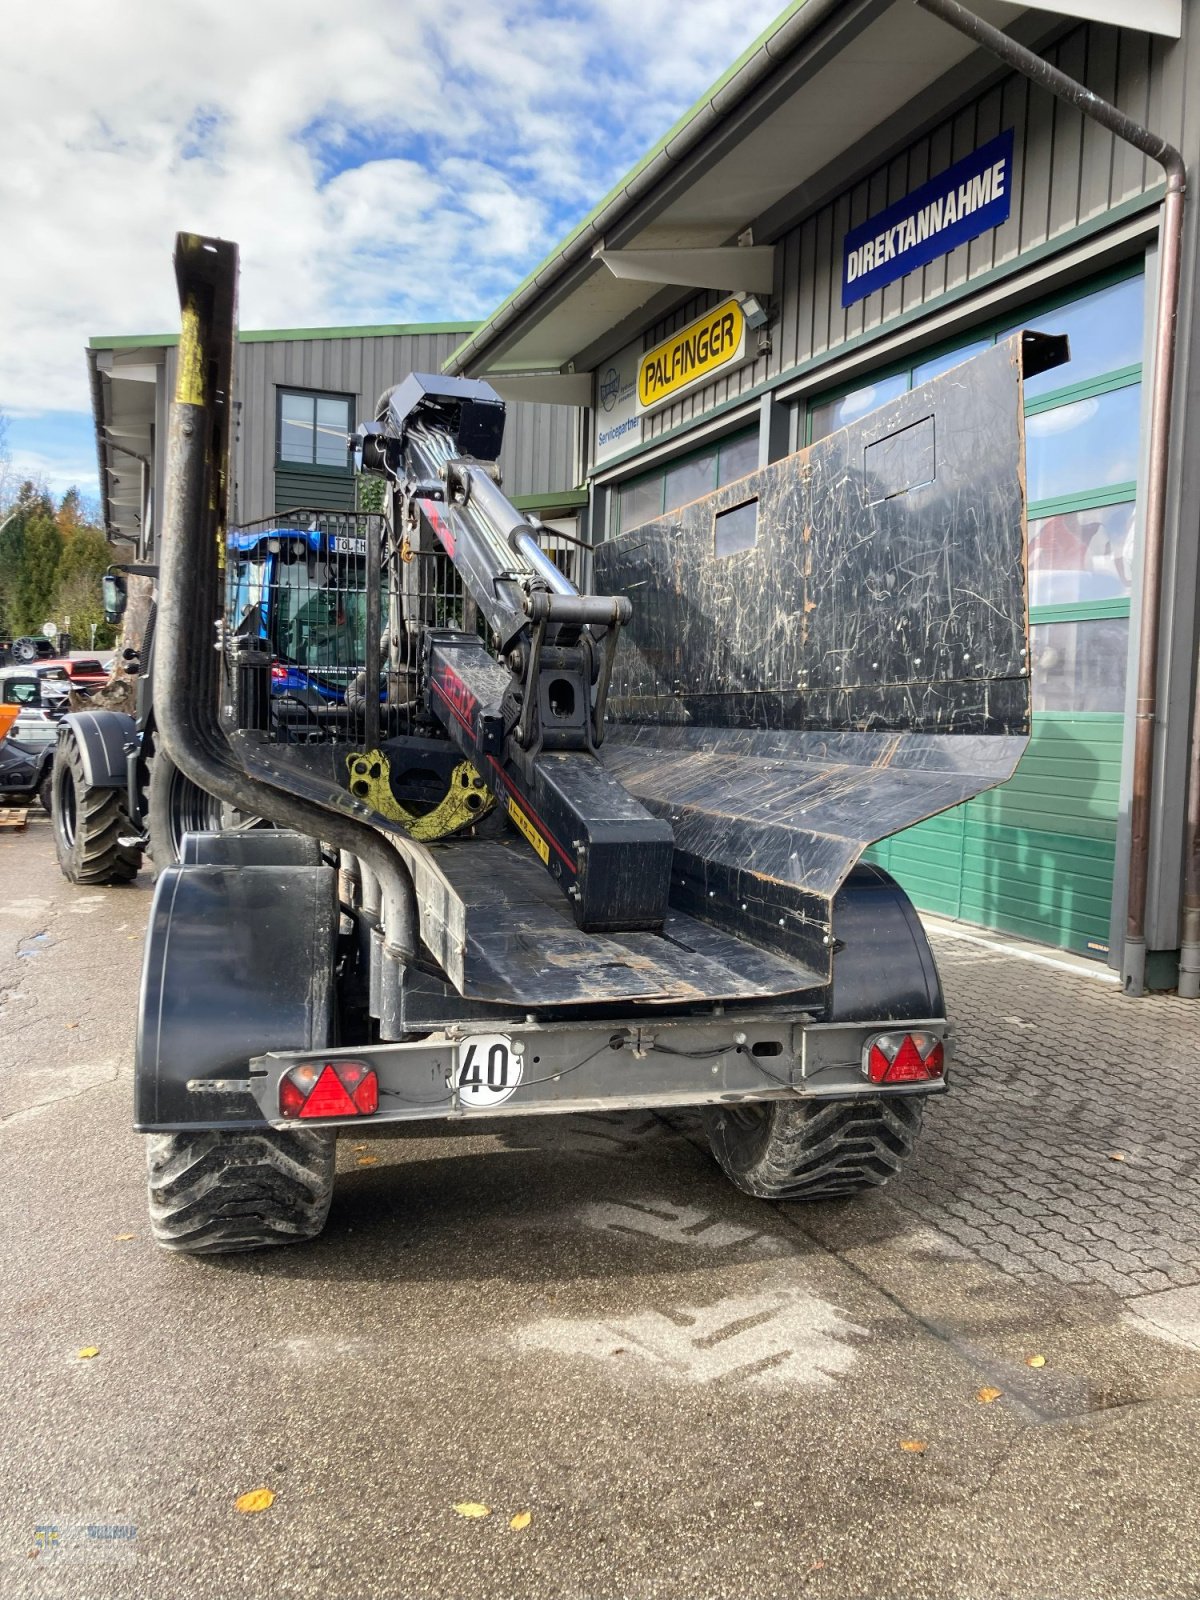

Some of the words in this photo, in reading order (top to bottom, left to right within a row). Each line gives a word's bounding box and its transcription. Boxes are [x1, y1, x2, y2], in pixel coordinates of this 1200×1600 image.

[847, 158, 1006, 284] DIREKTANNAHME
[644, 312, 735, 397] PALFINGER
[598, 415, 640, 447] Servicepartner
[458, 1043, 509, 1093] 40
